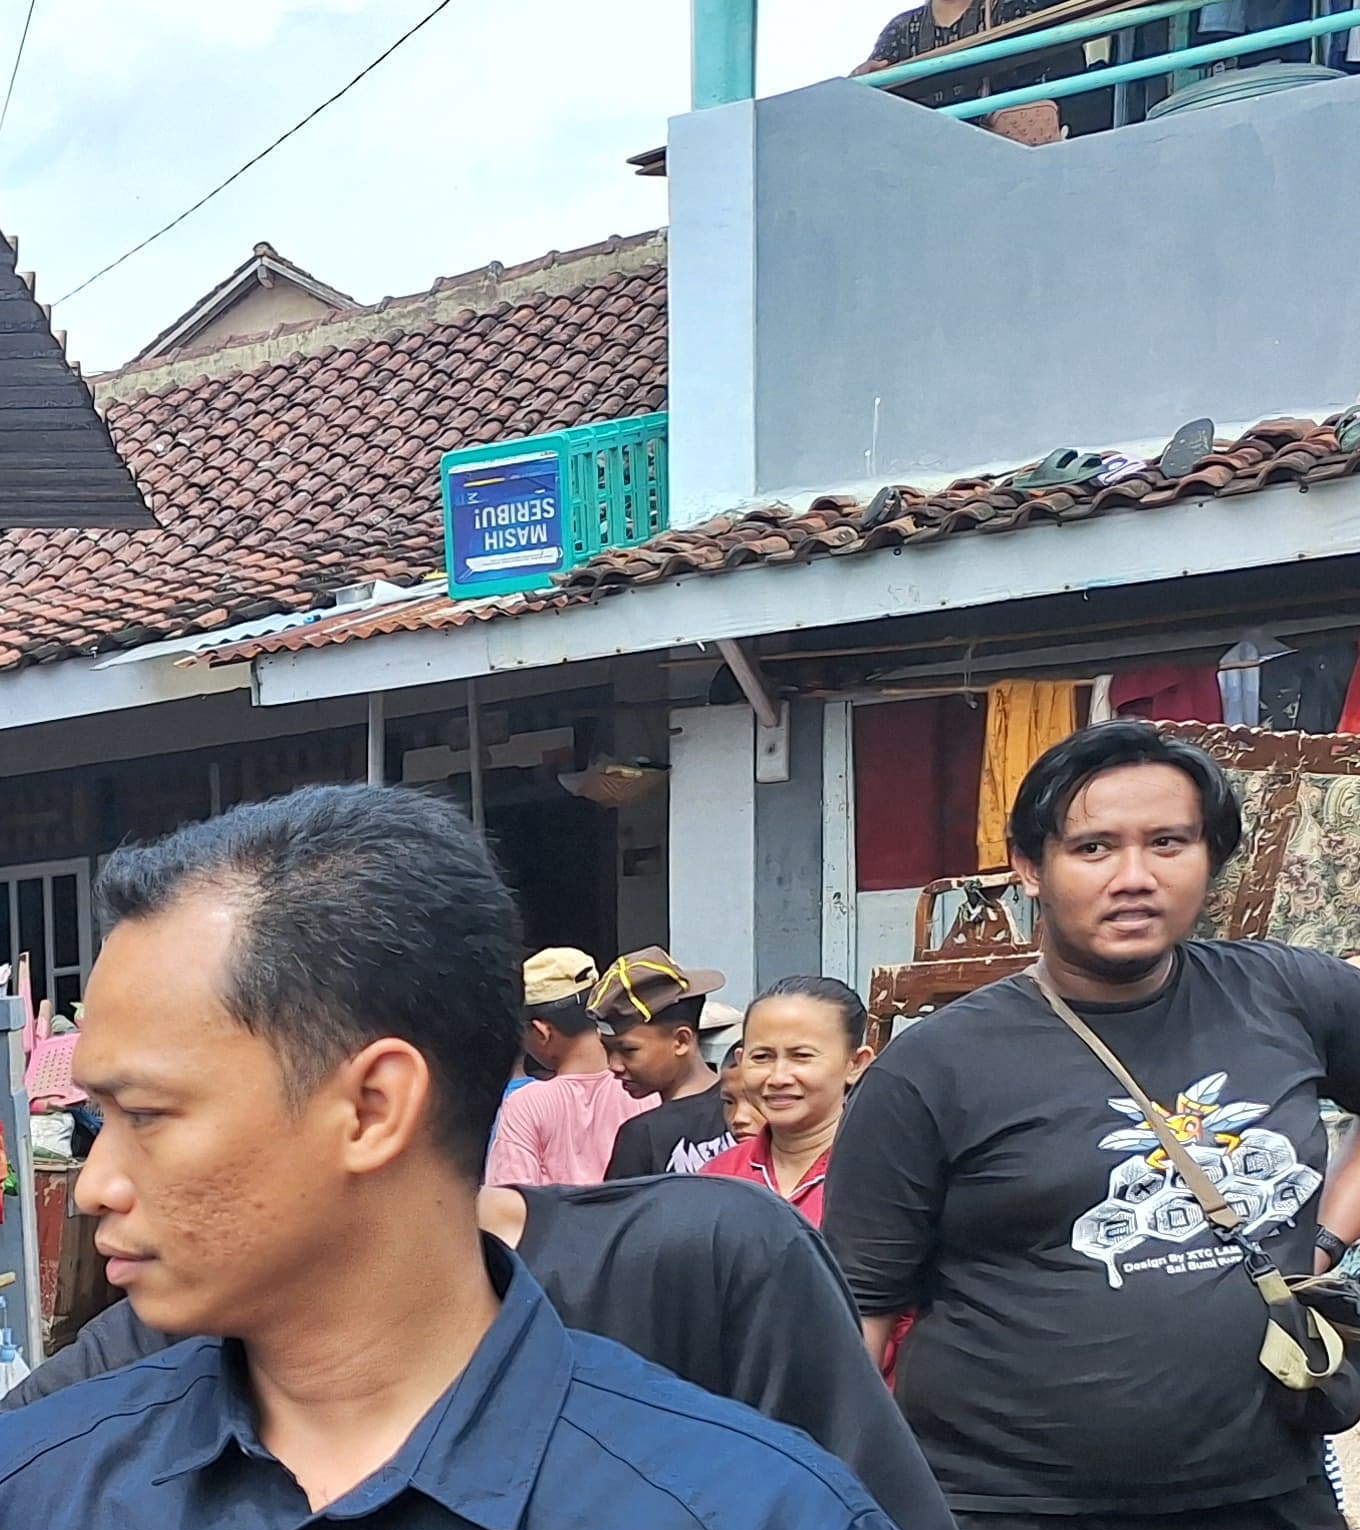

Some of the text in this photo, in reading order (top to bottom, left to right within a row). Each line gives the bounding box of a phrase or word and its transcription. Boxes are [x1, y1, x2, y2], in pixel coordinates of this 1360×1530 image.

[474, 498, 555, 529] SERIBU!
[484, 523, 547, 551] MASIH
[1123, 1257, 1167, 1273] Design
[1167, 1253, 1185, 1263] By
